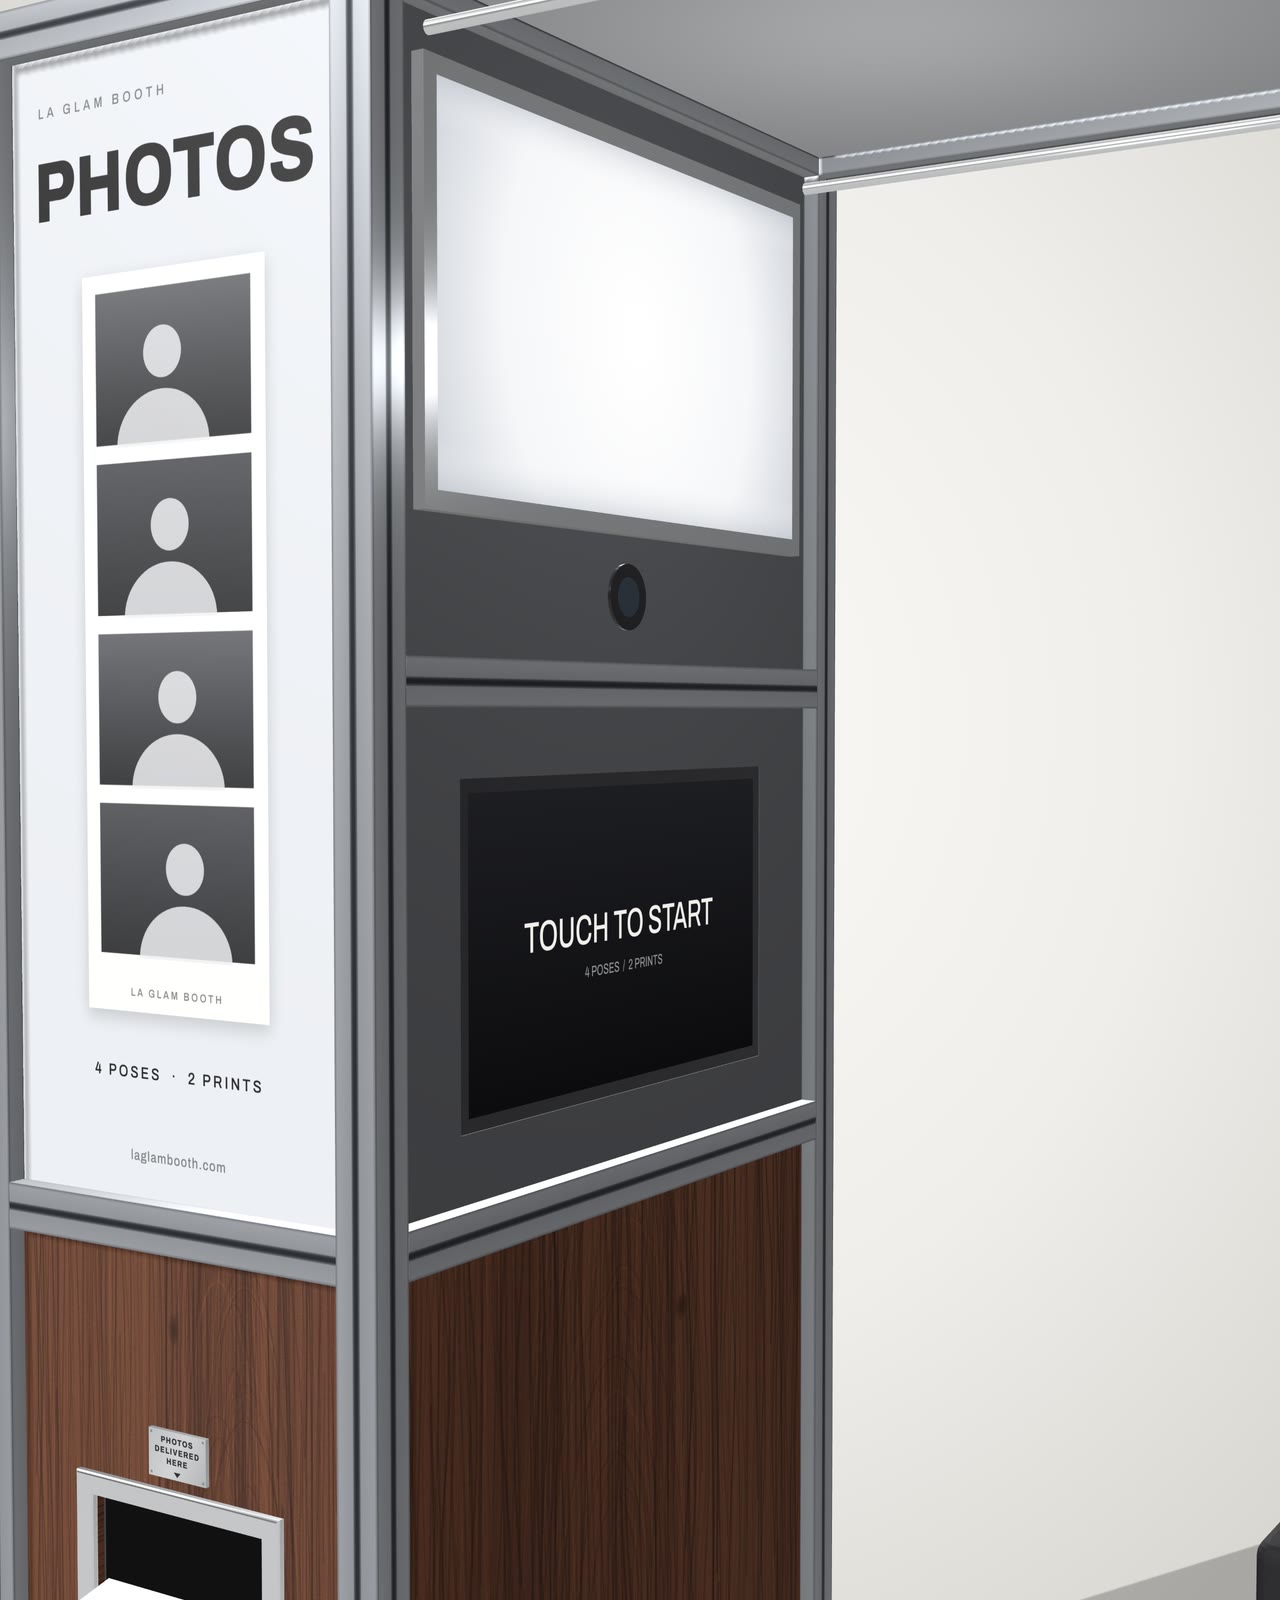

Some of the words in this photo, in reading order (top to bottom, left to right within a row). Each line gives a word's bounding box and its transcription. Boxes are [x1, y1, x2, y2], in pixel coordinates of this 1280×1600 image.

[38, 107, 54, 120] LA
[63, 96, 102, 114] GLAM
[111, 84, 164, 105] BOOTH
[38, 115, 314, 223] PHOTOS
[523, 911, 608, 954] TOUCH
[613, 907, 644, 940] TO
[648, 896, 714, 935] START
[584, 966, 591, 978] 4
[591, 961, 620, 977] POSES
[628, 959, 634, 971] 2
[634, 953, 664, 969] PRINTS
[130, 987, 144, 998] LA
[148, 989, 179, 1001] GLAM
[183, 992, 222, 1005] BOOTH
[95, 1061, 103, 1074] 4
[109, 1063, 160, 1081] POSES
[187, 1072, 196, 1086] 2
[202, 1074, 262, 1094] PRINTS
[130, 1148, 226, 1174] laglambooth.com
[154, 1444, 199, 1461] DELIVERED
[160, 1435, 193, 1449] PHOTOS
[166, 1457, 187, 1469] HERE
